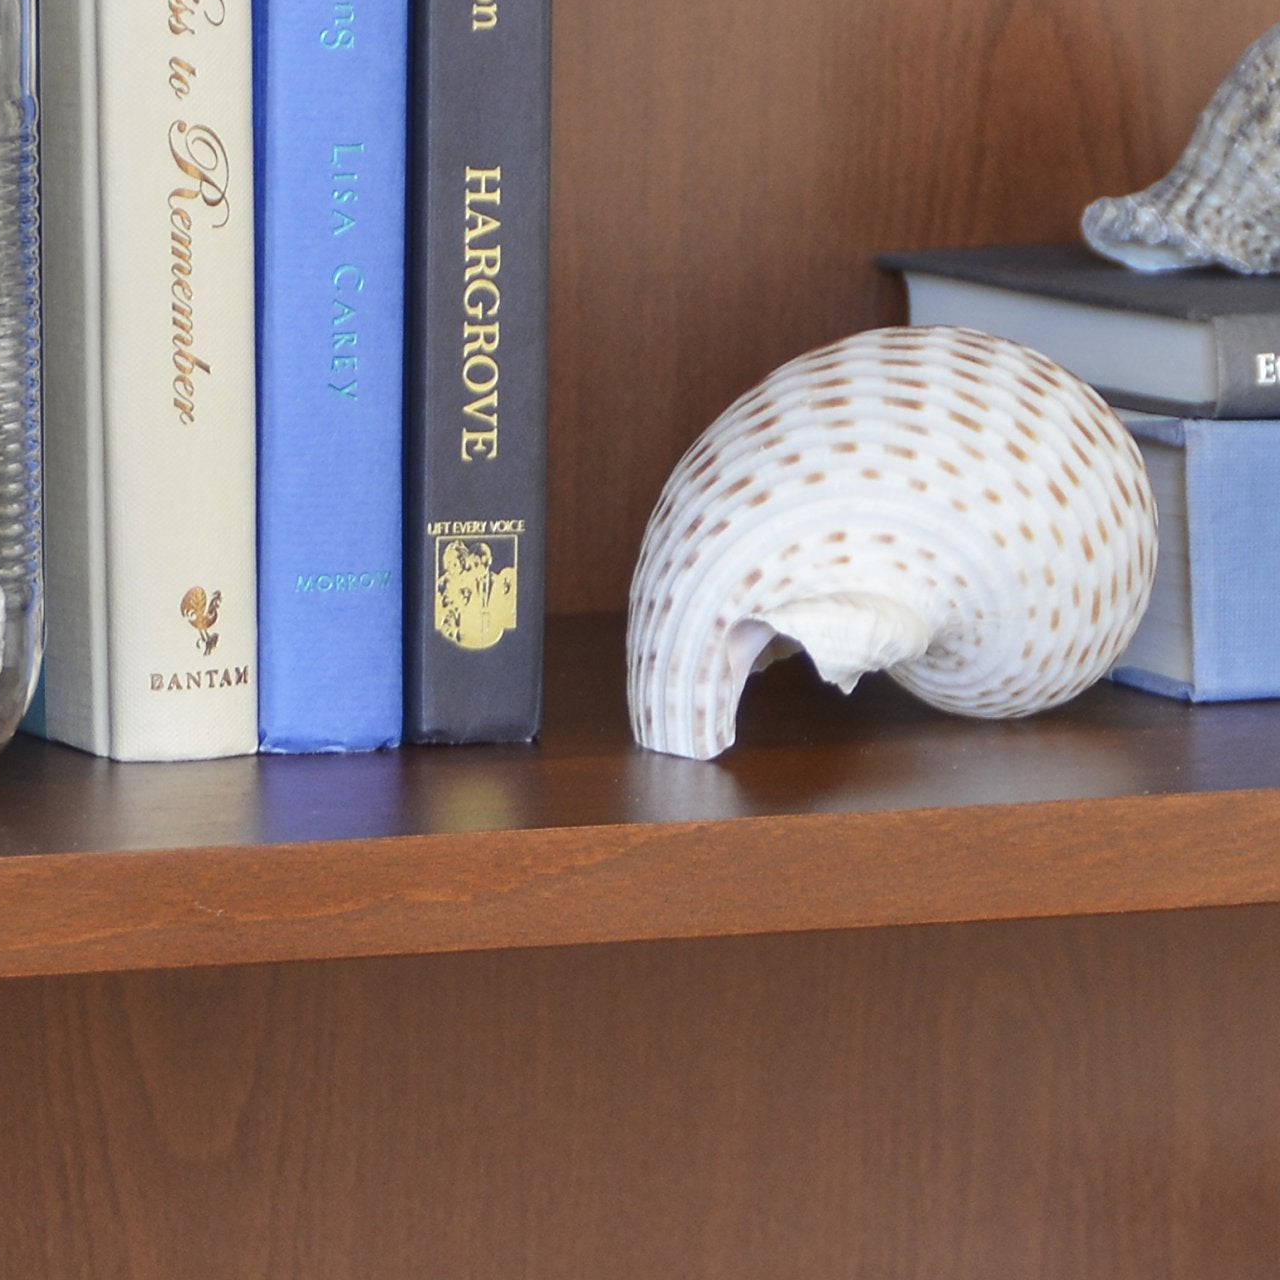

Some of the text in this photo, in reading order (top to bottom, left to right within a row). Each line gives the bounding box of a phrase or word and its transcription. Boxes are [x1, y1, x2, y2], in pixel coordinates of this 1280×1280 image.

[168, 57, 197, 100] to
[167, 120, 230, 425] Remember
[327, 143, 365, 402] LISA CAREY
[461, 166, 502, 462] HARGROVE
[427, 519, 526, 535] LIFT EVERY VOICE
[294, 571, 392, 593] MORROW
[149, 665, 249, 691] BANTAM
